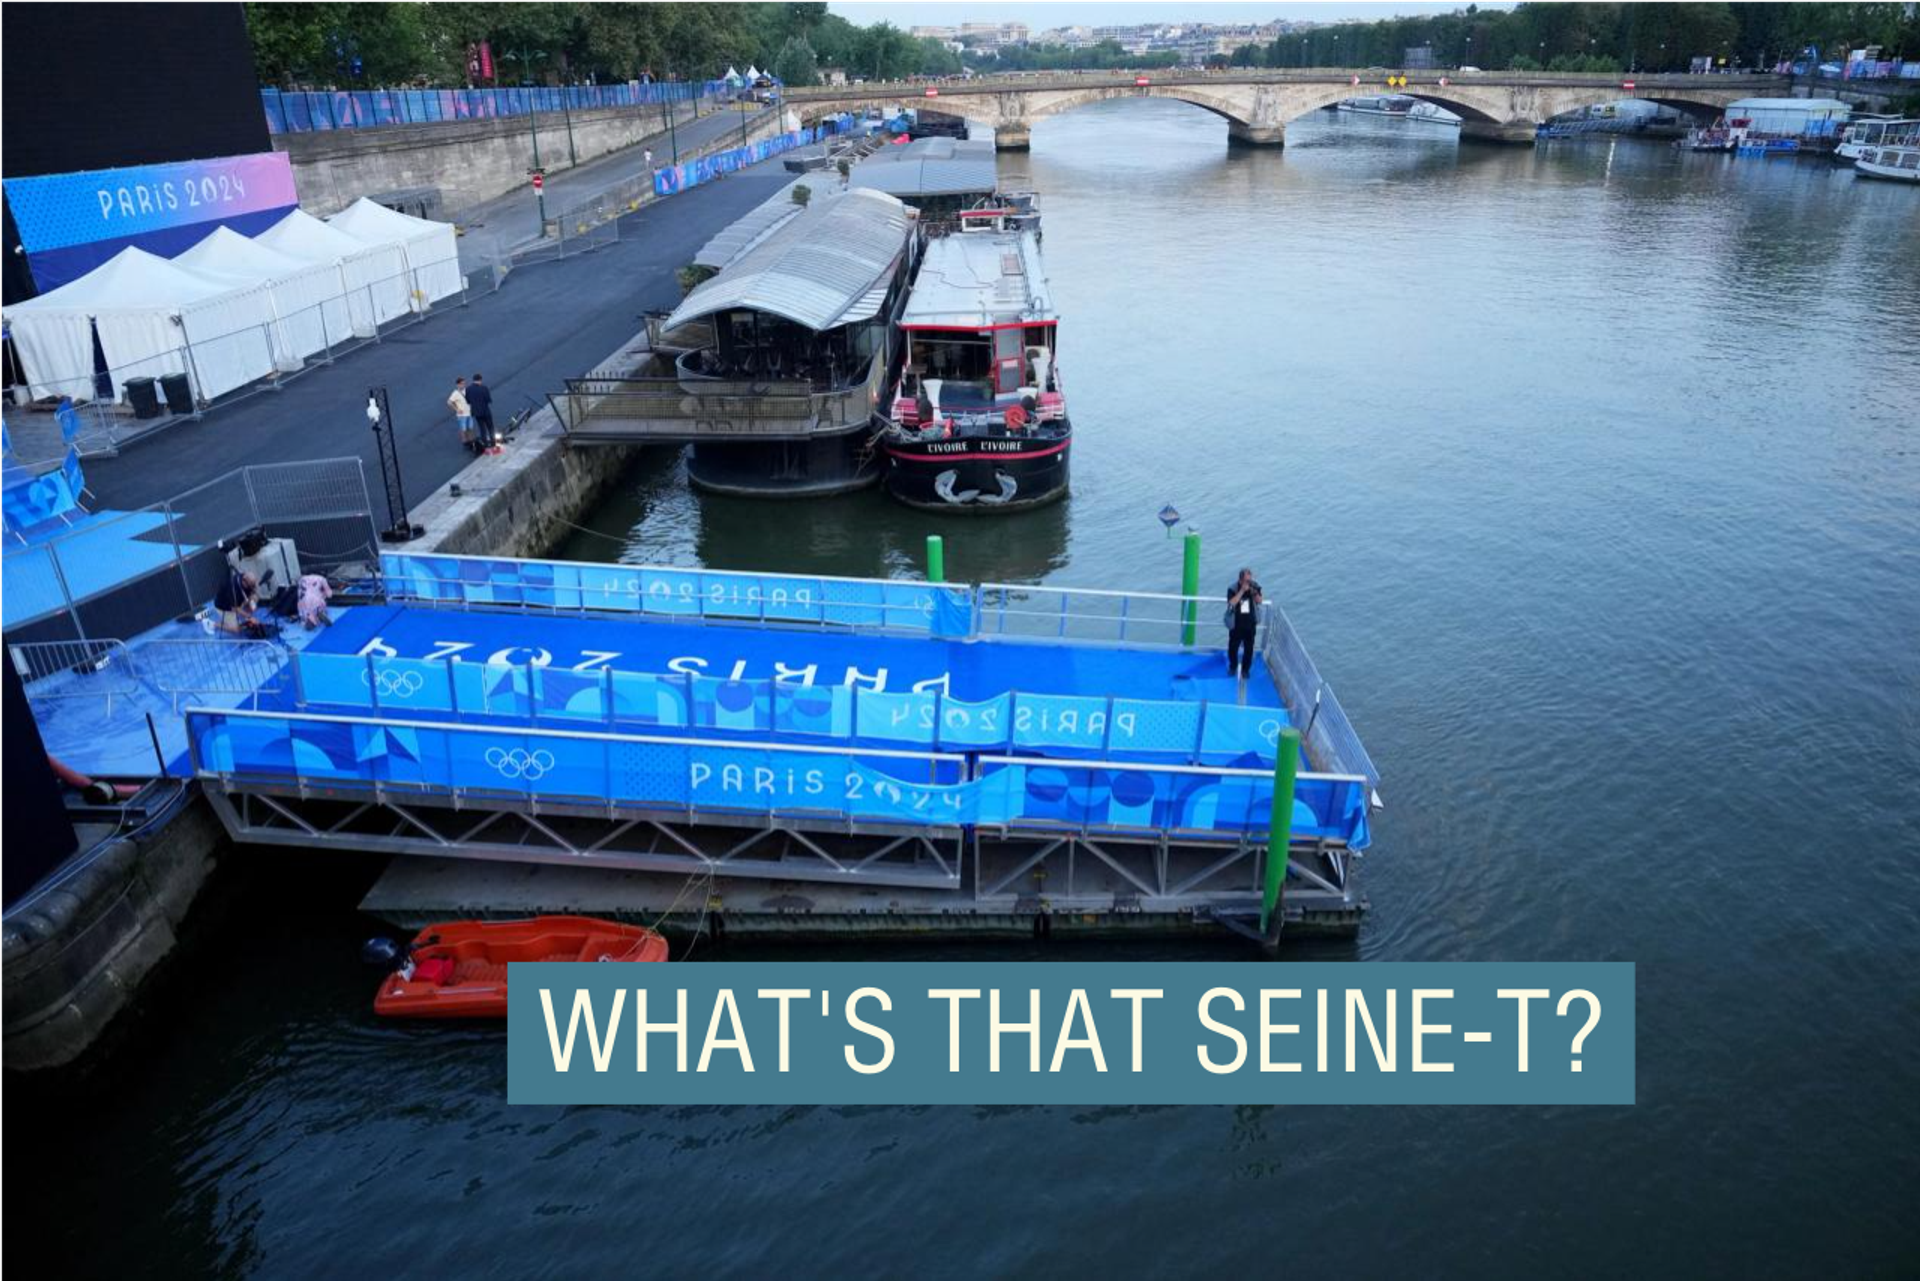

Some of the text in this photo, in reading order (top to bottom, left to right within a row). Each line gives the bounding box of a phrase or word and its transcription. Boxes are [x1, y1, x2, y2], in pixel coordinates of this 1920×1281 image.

[184, 173, 246, 207] 2024
[927, 440, 1022, 453] L'IVOIRE L'IVOIRE
